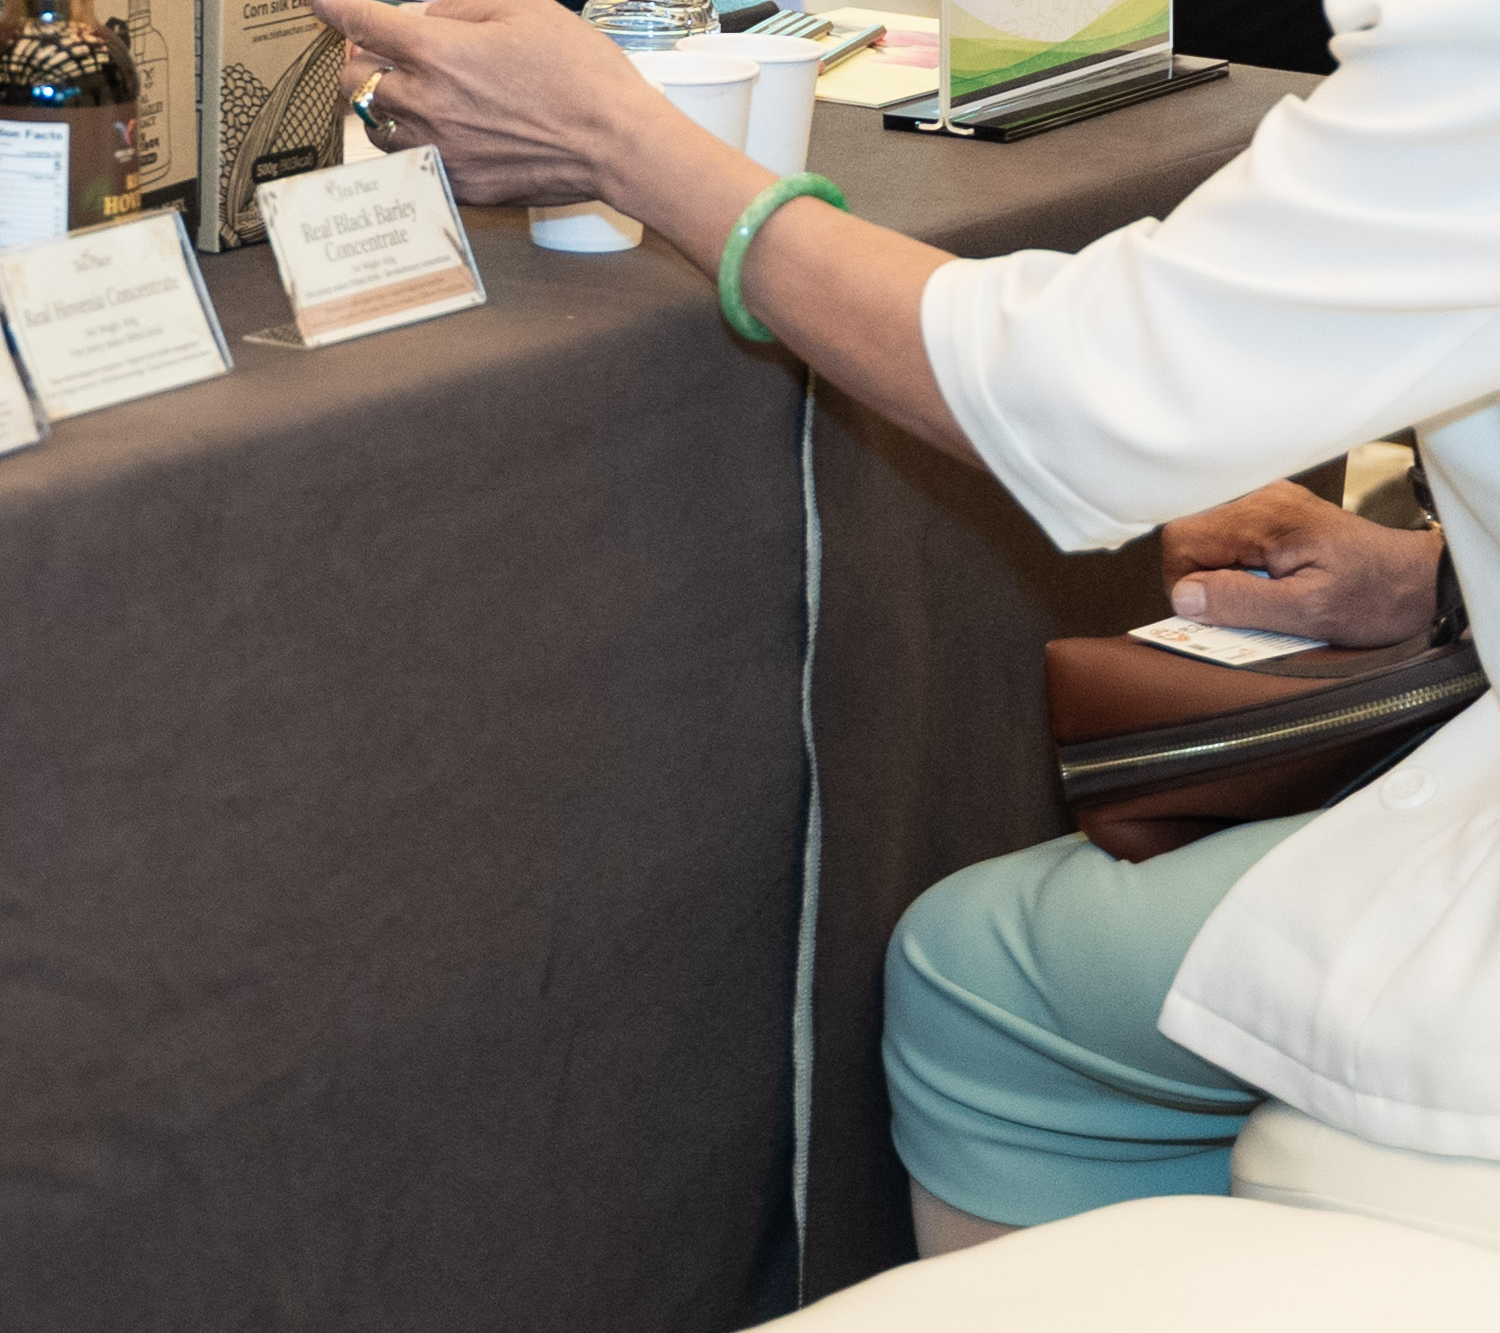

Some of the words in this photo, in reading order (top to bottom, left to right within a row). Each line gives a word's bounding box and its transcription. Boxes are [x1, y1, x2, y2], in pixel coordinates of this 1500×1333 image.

[243, 3, 268, 19] Corn
[25, 130, 62, 140] Facts
[301, 220, 333, 244] Real
[335, 211, 372, 236] Black
[373, 199, 416, 224] Barley
[325, 228, 409, 262] Concentrate
